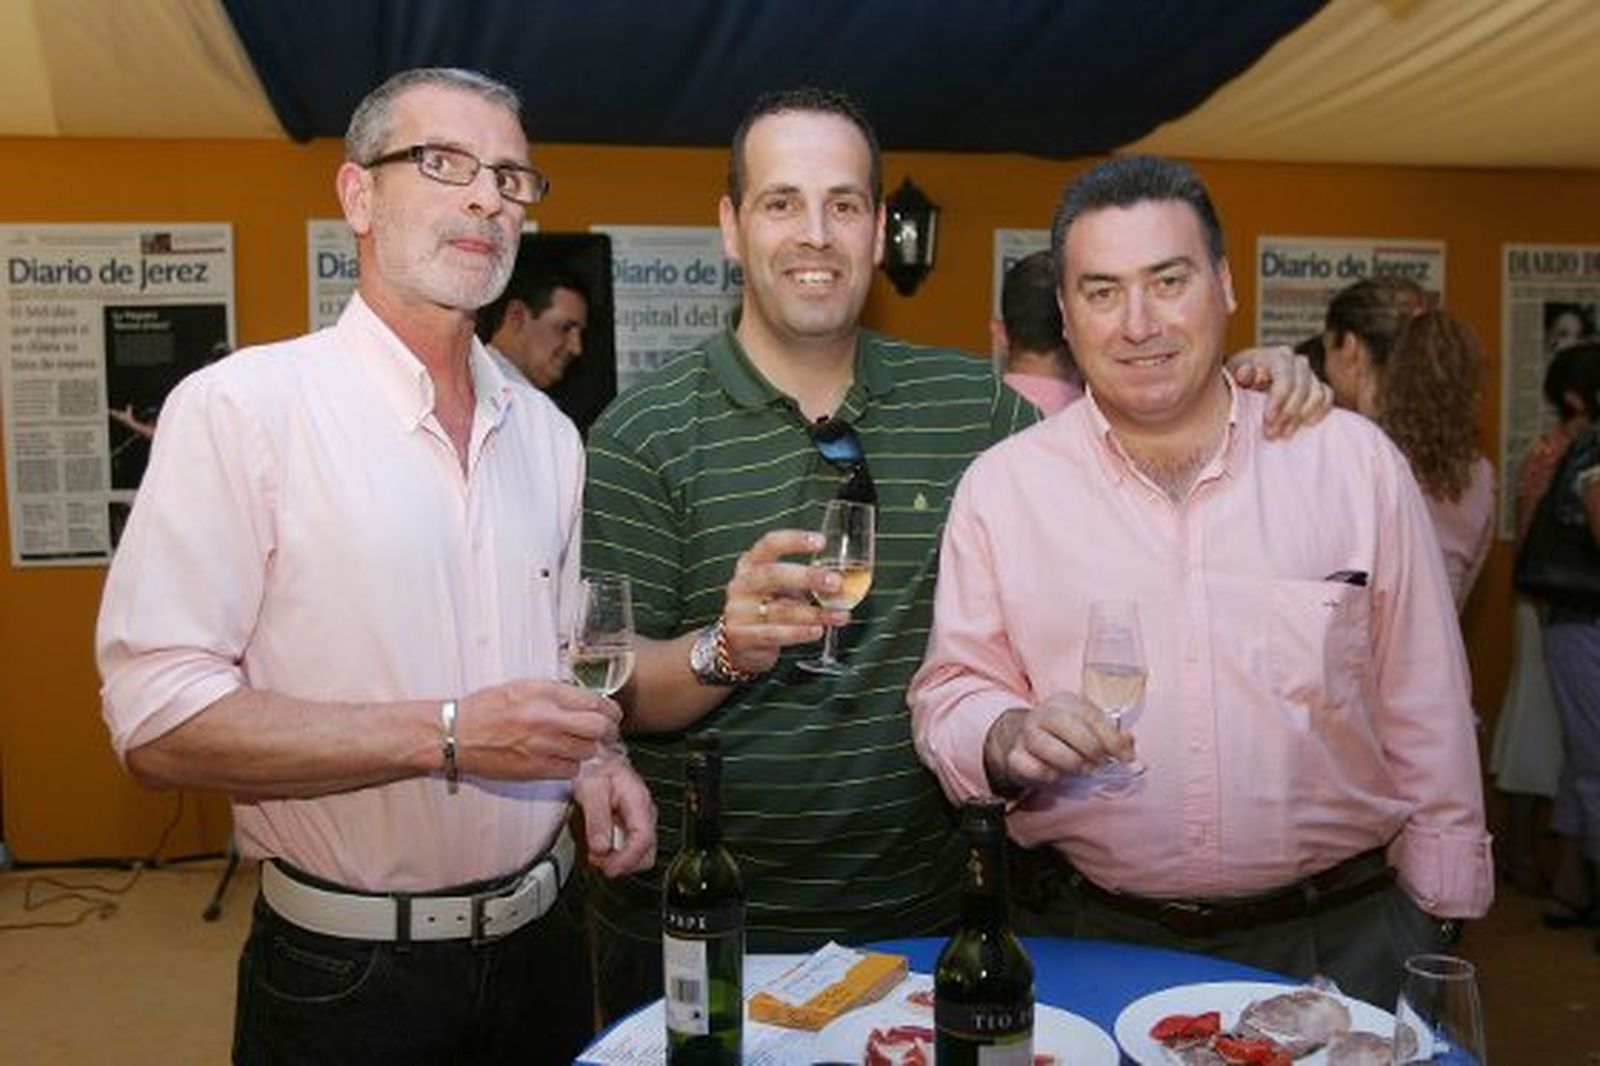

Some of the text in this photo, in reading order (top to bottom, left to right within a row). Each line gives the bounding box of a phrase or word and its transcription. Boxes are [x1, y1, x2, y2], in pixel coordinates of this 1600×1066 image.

[8, 258, 208, 291] Diario de Jerez
[318, 251, 360, 279] Dia
[684, 258, 717, 285] de
[721, 258, 745, 292] Je
[1262, 252, 1331, 277] Diario
[1336, 254, 1366, 277] de
[1508, 250, 1580, 275] DIARIO
